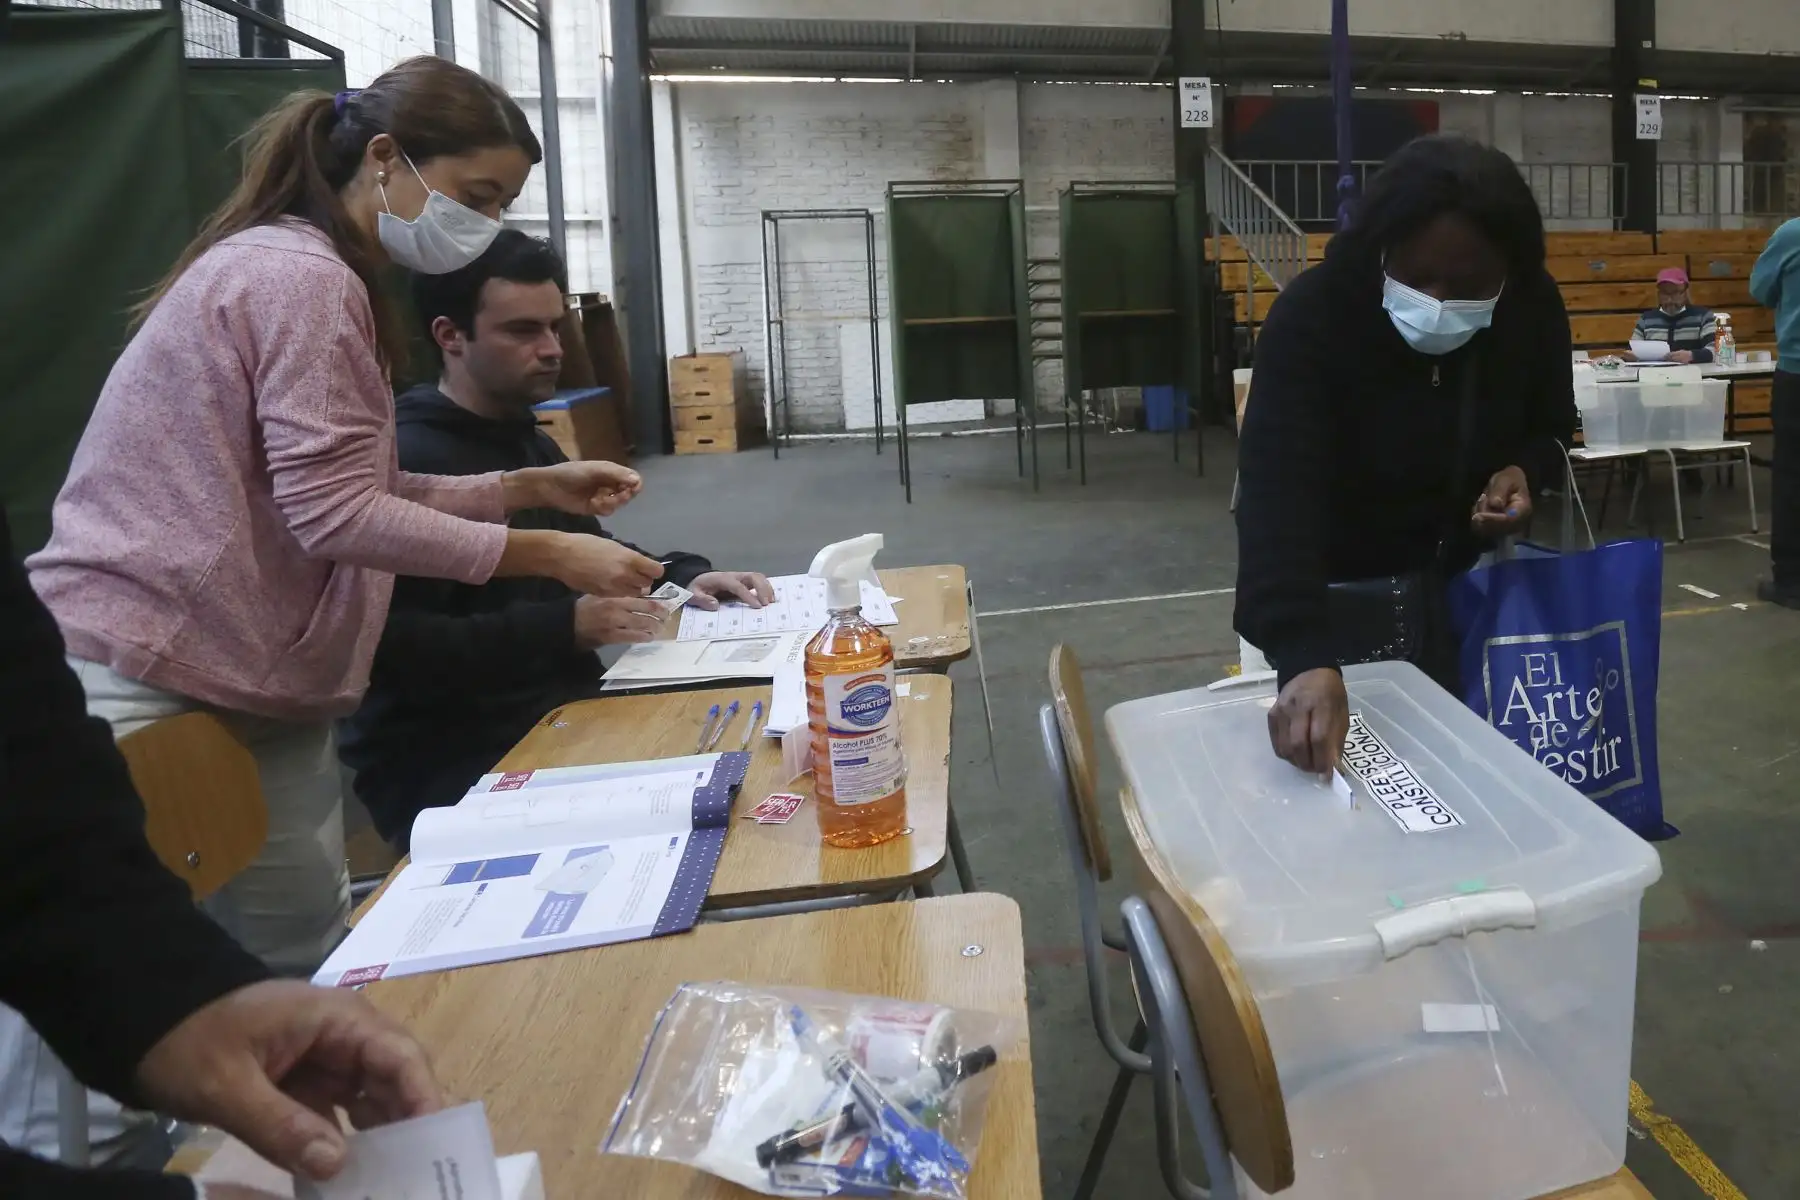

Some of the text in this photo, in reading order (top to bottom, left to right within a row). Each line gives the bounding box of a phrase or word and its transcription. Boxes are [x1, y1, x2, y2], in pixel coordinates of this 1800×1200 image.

[1185, 110, 1209, 122] 228
[1639, 123, 1659, 135] 229
[1520, 651, 1565, 688] El
[843, 695, 891, 713] WORKTEEN
[1499, 675, 1603, 727] Arte
[832, 741, 858, 749] Alcohol
[860, 738, 875, 746] PLUS
[1530, 712, 1570, 750] de
[1349, 718, 1452, 826] CONSTITUCIONAL
